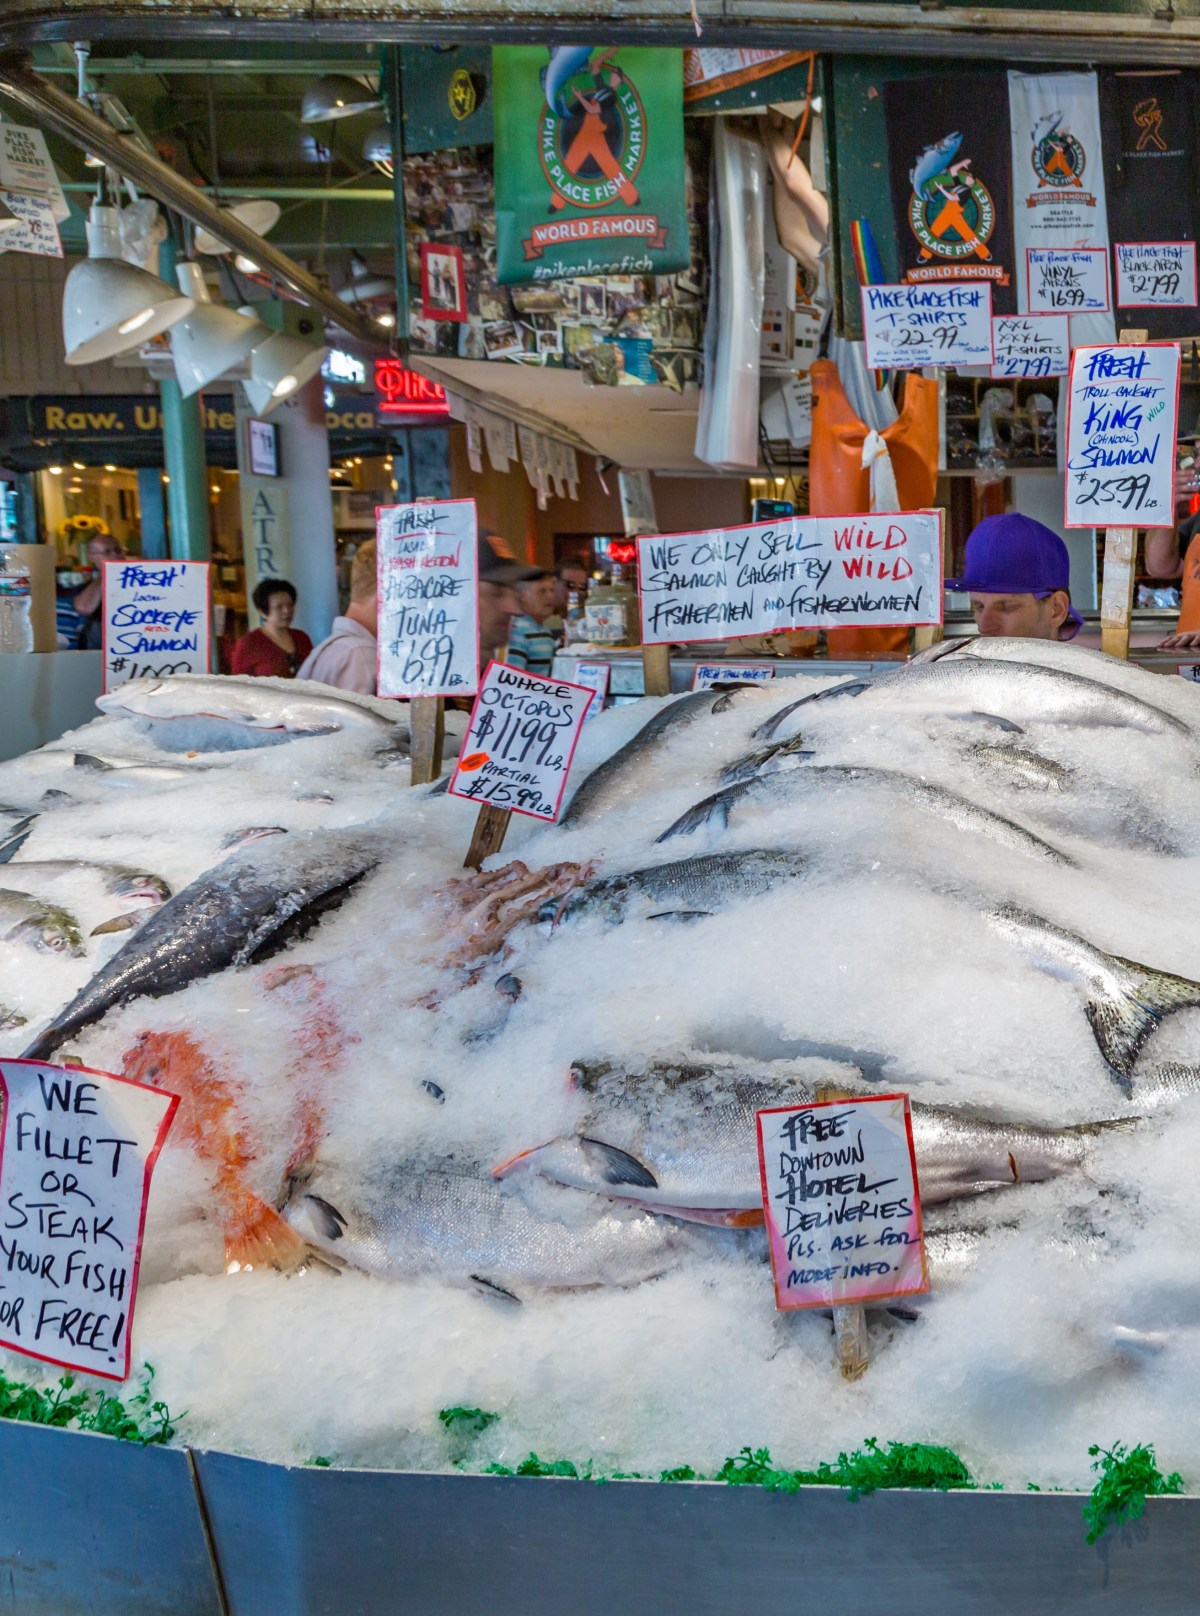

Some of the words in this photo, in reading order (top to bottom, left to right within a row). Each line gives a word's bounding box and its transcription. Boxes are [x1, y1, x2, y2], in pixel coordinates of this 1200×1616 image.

[543, 117, 557, 163] PIKE
[610, 91, 643, 172] MARKET
[549, 164, 591, 202] PLACE
[594, 172, 626, 201] FISH
[534, 221, 589, 242] WORLD
[592, 218, 656, 235] FAMOUS
[912, 199, 923, 229] PIKE
[919, 230, 953, 255] PLACE
[955, 236, 981, 255] FISH
[974, 188, 992, 239] MARKET
[909, 267, 951, 280] WORLD
[953, 266, 1002, 277] FAMOUS
[1040, 264, 1088, 280] VINYL
[1122, 259, 1152, 273] BLACK
[868, 288, 908, 310] PIKE
[907, 286, 949, 309] PLACE
[949, 286, 985, 308] FISH
[875, 310, 968, 327] T-SHIRTS
[999, 319, 1034, 333] XXL
[995, 344, 1062, 356] T-SHIRTS
[999, 332, 1053, 344] XXXL
[1083, 348, 1151, 382] FRESH
[1076, 383, 1165, 402] TROLL-CAUGHT
[46, 405, 124, 430] Raw.
[1084, 401, 1143, 435] KING
[1146, 401, 1166, 423] WILD
[1068, 434, 1160, 469] SALMON
[1088, 431, 1140, 448] (CHINOOK)
[1074, 471, 1151, 511] $25.99
[649, 543, 688, 570] WE
[691, 536, 750, 567] ONLY
[757, 531, 823, 561] SELL
[834, 521, 908, 551] WILD
[385, 574, 471, 602] ALBACORE
[641, 566, 729, 592] SALMON
[736, 561, 805, 588] CAUGHT
[805, 557, 833, 591] BY
[842, 554, 914, 581] WILD
[112, 604, 202, 632] SOCKEYE
[388, 606, 458, 638] TUNA
[648, 588, 754, 634] FISHERMEN
[763, 599, 786, 613] AND
[785, 576, 924, 618] FISHERWOMEN
[110, 632, 198, 655] SALMON
[497, 670, 573, 699] WHOLE
[480, 687, 574, 727] OCTOPUS
[469, 709, 558, 765] $11.99
[481, 760, 542, 785] PARTIAL
[459, 776, 543, 808] $15.99
[38, 1073, 101, 1115] WE
[16, 1112, 138, 1178] FILLET
[780, 1109, 856, 1151] FREE
[41, 1170, 95, 1207] OR
[5, 1192, 124, 1251] STEAK
[782, 1196, 914, 1238] DELIVERIES
[787, 1234, 822, 1261] PLS.
[831, 1234, 869, 1250] ASK
[874, 1227, 921, 1246] FOR
[0, 1234, 60, 1288] YOUR
[64, 1250, 127, 1301] FISH
[787, 1265, 842, 1288] MORE
[842, 1256, 899, 1279] INFO.
[35, 1299, 126, 1362] FREE!
